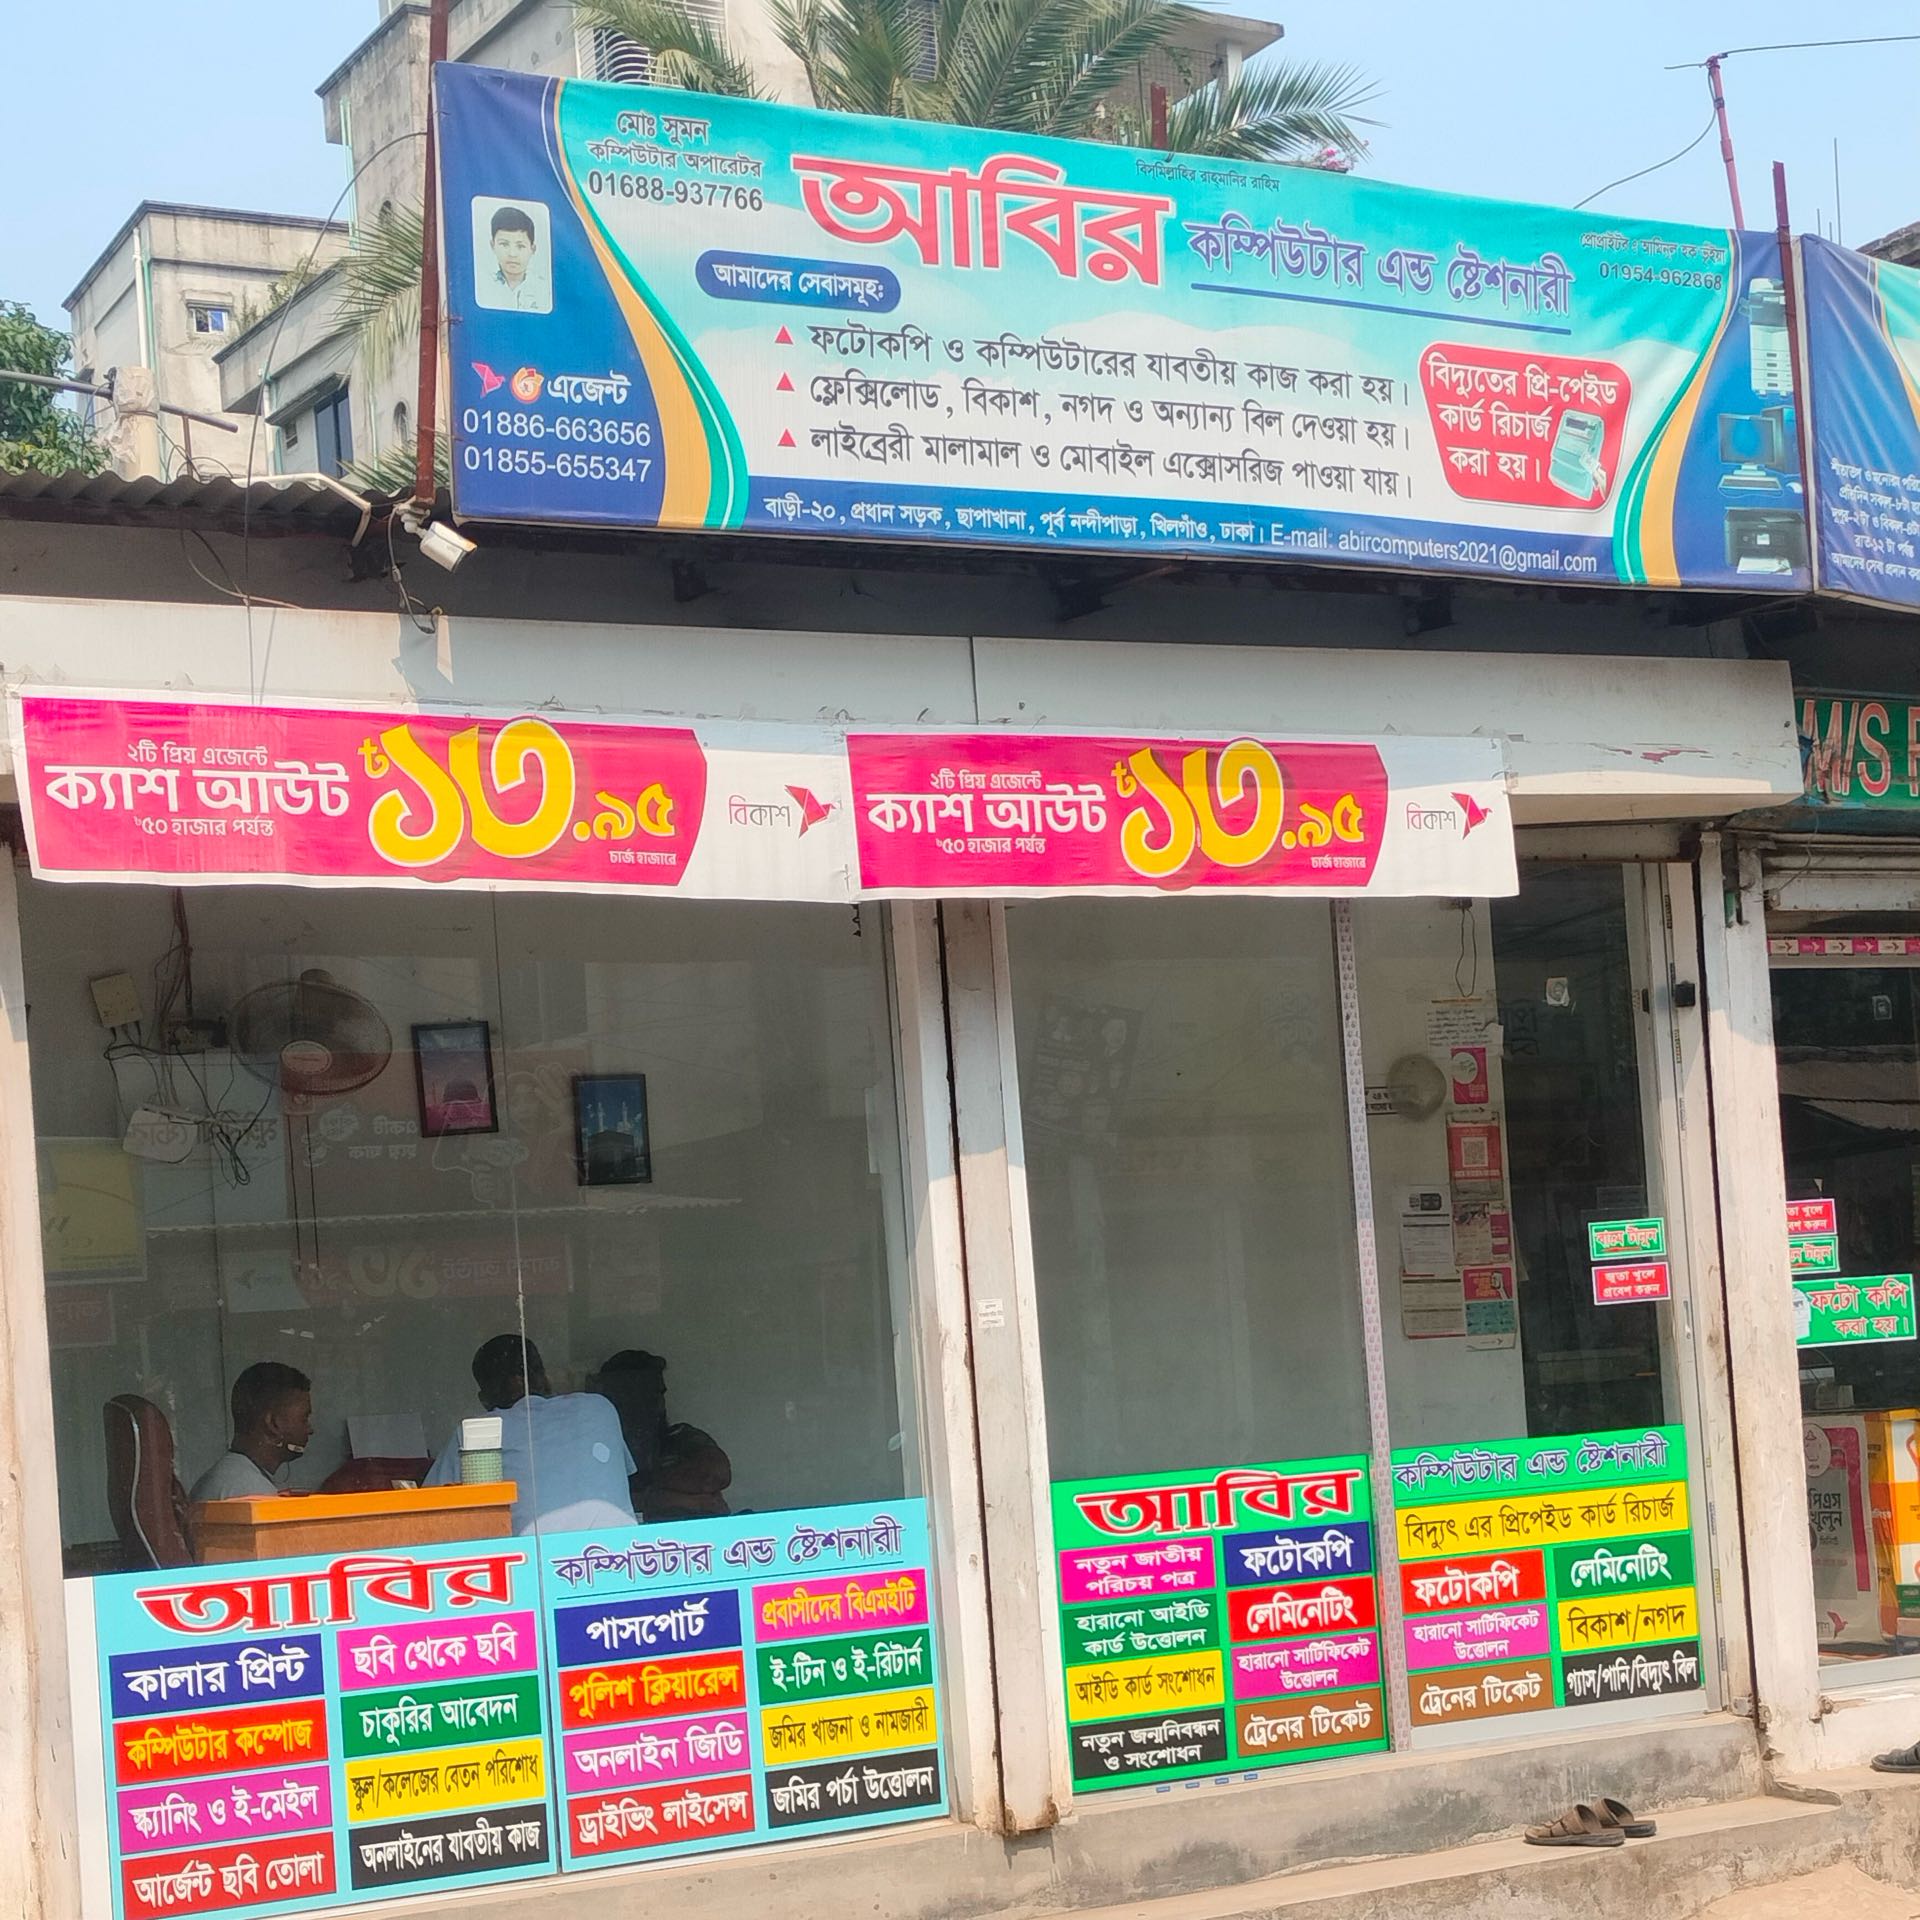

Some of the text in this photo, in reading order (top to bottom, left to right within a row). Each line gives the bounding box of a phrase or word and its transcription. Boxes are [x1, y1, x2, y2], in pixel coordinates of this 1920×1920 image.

[617, 111, 708, 145] মোঃ সুমন
[588, 141, 763, 178] কম্পিউটার অপারেটর
[589, 171, 763, 212] 01688-937766
[1251, 174, 1280, 191] রাহিম
[790, 153, 1172, 286] আবির
[712, 264, 792, 292] আমাদের
[1184, 212, 1576, 315] কম্পিউটার এন্ড ষ্টেশনারী
[1600, 262, 1722, 290] 01954-962868
[807, 319, 932, 362] ফটোকপি
[944, 339, 964, 363] ও
[972, 333, 1137, 379] কম্পিউটারের
[1145, 348, 1238, 387] যাবতীয়
[1244, 361, 1299, 393] কাজ
[1305, 368, 1353, 399] করা
[1426, 351, 1619, 406] বিদ্যুতের প্রি-পেইড
[547, 369, 632, 406] এজেন্ট
[463, 409, 650, 447] 01886-663656
[1057, 393, 1117, 424] নগদ
[1124, 400, 1143, 423] ও
[1151, 400, 1235, 432] অন্যান্য
[1242, 400, 1284, 436] বিল
[1292, 413, 1357, 444] দেওয়া
[1437, 399, 1552, 442] কার্ড রিচার্জ
[464, 446, 651, 483] 01855-655347
[810, 420, 914, 465] লাইব্রেরী
[921, 433, 1021, 468] মালামাল
[1031, 445, 1050, 468] ও
[1059, 438, 1155, 477] মোবাইল
[1292, 461, 1354, 492] পাওয়া
[1447, 447, 1490, 477] করা
[850, 502, 895, 525] প্রধান
[1039, 507, 1065, 538] পূর্ব
[1271, 524, 1334, 550] E-mail:
[1338, 530, 1597, 573] abircomputers2021@gmail.com
[127, 739, 268, 767] ২টি প্রিয় এজেন্টে
[44, 761, 350, 817] ক্যাশ আউট
[930, 768, 1042, 790] ২টি প্রিয় এজেন্টে
[171, 819, 227, 837] হাজার
[232, 817, 274, 838] পর্যন্ত
[728, 794, 792, 827] বিকাশ
[866, 784, 1107, 834] ক্যাশ আউট
[1406, 802, 1456, 832] বিকাশ
[609, 848, 676, 867] চার্জ হাজারে
[967, 837, 1012, 854] হাজার
[1015, 835, 1047, 855] পর্যন্ত
[1311, 855, 1367, 870] চার্জ হাজারে
[1807, 1278, 1908, 1314] ফটো কপি
[1833, 1316, 1868, 1337] করা
[1392, 1431, 1668, 1491] কম্পিউটার এন্ড ষ্টেশনারী
[1074, 1469, 1363, 1536] আবির
[1405, 1488, 1675, 1550] বিদ্যুৎ এর প্রিপেইড কার্ড রিচার্জ
[551, 1515, 905, 1587] কম্পিউটার এন্ড ষ্টেশনারী
[1074, 1545, 1203, 1575] নতুন জাতীয়
[1240, 1529, 1353, 1577] ফটোকপি
[1570, 1543, 1672, 1588] লেমিনেটিং
[134, 1553, 528, 1636] আবির
[762, 1576, 916, 1631] প্রবাসীদের বিএমইটি
[1085, 1571, 1197, 1596] পরিচয় পত্র
[1411, 1560, 1520, 1608] ফটোকপি
[586, 1598, 709, 1650] পাসপোর্ট
[1413, 1609, 1540, 1643] হারানো সার্টিফিকেট
[1567, 1603, 1687, 1643] বিকাশ/নগদ
[351, 1623, 518, 1679] ছবি থেকে ছবি
[1454, 1640, 1509, 1660] উত্তোলন
[123, 1643, 310, 1702] কালার প্রিন্ট
[570, 1664, 739, 1719] পুলিশ ক্লিয়ারেন্স
[1419, 1672, 1543, 1716] ট্রেনের টিকেট
[1567, 1650, 1697, 1700] গ্যাস/পানি/বিদ্যুৎ বিল
[359, 1693, 519, 1746] চাকুরির আবেদন
[124, 1719, 313, 1770] কম্পিউটার কম্পোজ
